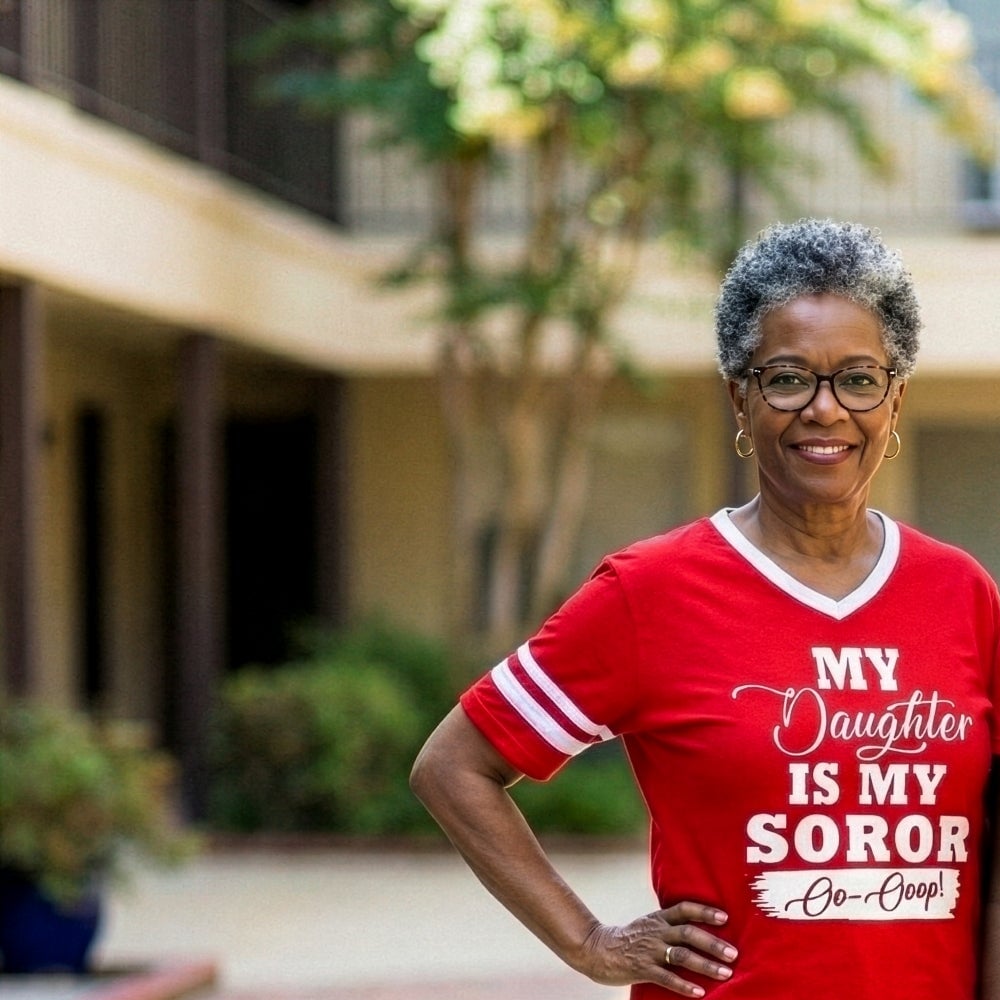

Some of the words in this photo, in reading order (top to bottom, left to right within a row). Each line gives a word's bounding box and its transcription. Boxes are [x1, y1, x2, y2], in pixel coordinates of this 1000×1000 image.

[811, 646, 900, 692] MY
[731, 684, 973, 761] Daughter
[789, 763, 840, 806] IS
[859, 763, 947, 806] MY
[746, 813, 970, 864] SOROR
